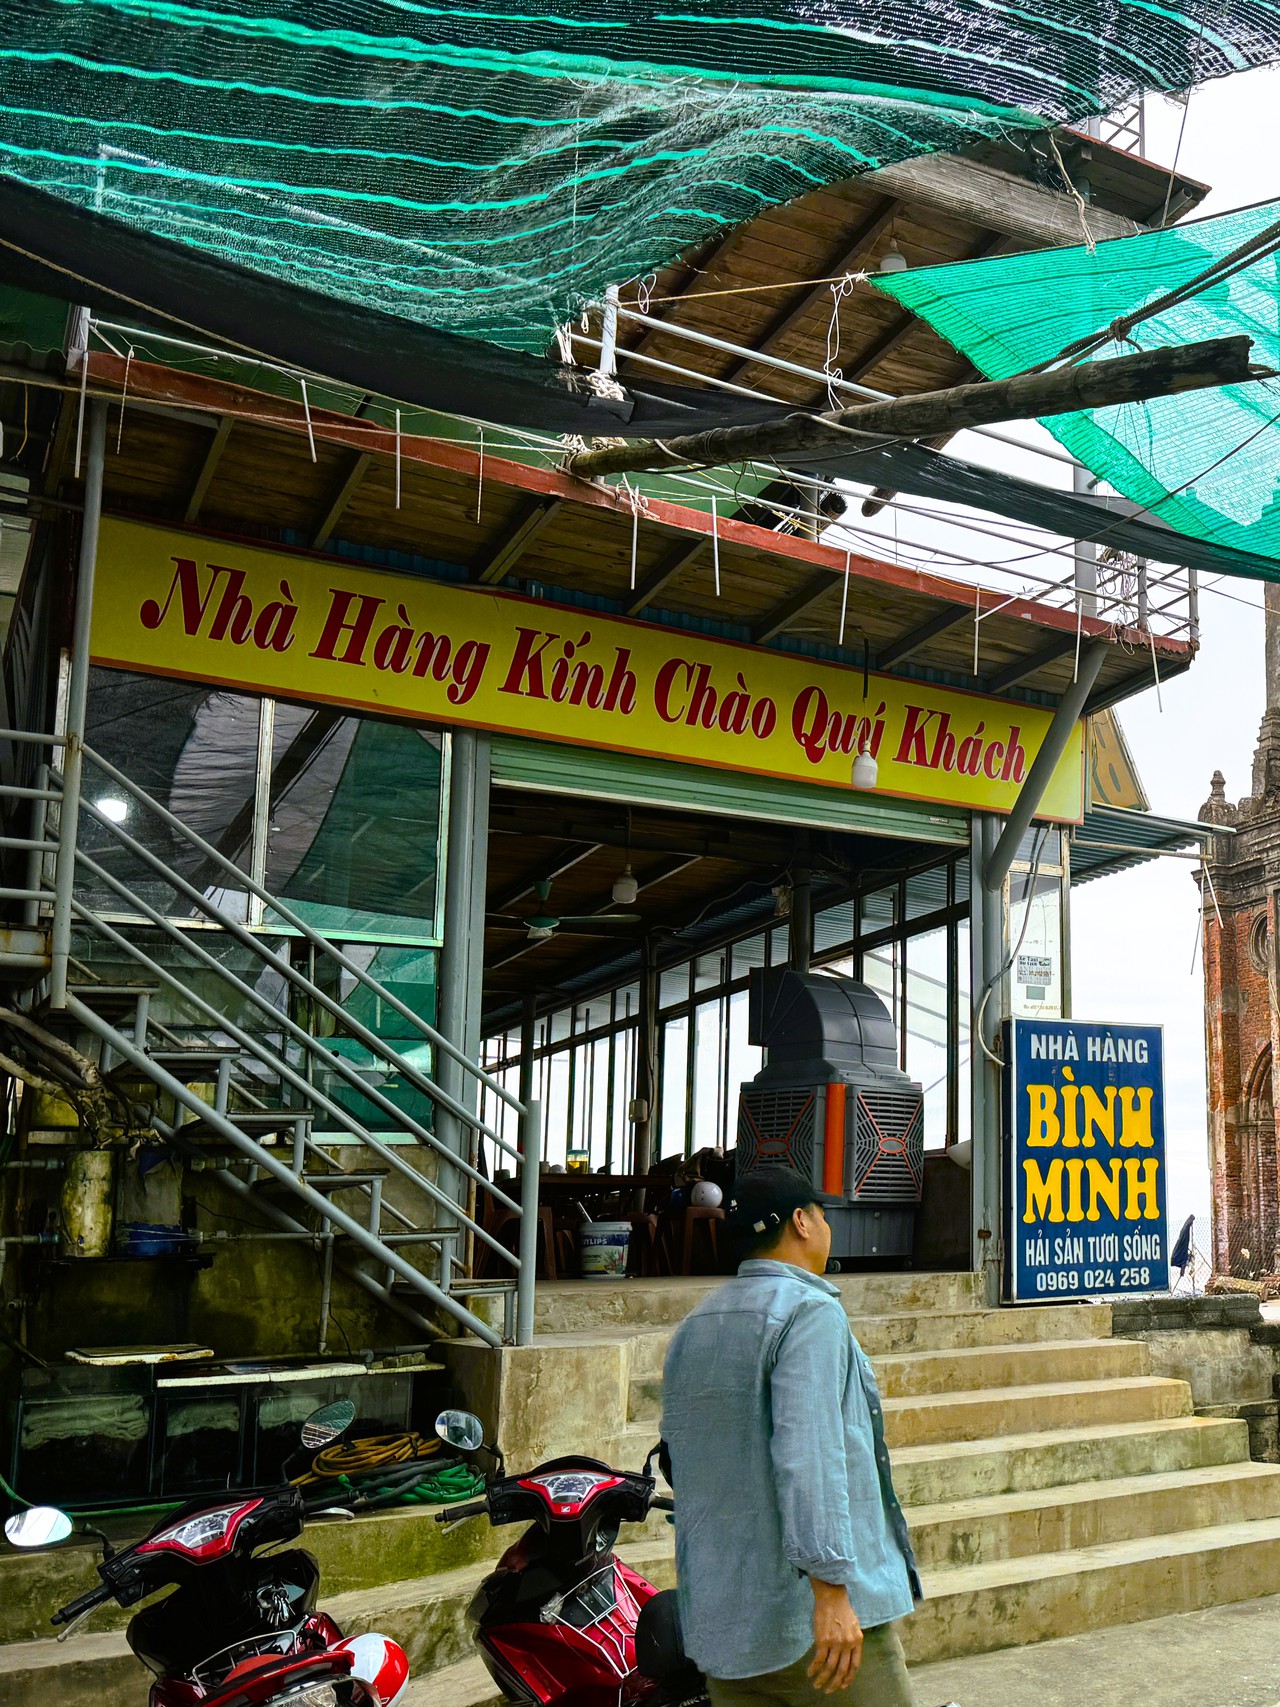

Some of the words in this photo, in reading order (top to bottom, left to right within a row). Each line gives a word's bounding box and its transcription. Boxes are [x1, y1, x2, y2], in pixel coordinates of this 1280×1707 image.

[140, 555, 297, 653] Nhà
[308, 588, 491, 706] Hàng
[497, 627, 638, 716] Kính
[653, 658, 777, 740] Chào
[892, 704, 1026, 784] Khách
[1030, 1030, 1080, 1061] NHÀ
[1087, 1032, 1149, 1064] HÀNG
[1026, 1065, 1155, 1149] BÌNH
[1022, 1158, 1160, 1224] MINH
[1025, 1229, 1050, 1267] HẢI
[1054, 1228, 1084, 1266] SẢN
[1087, 1233, 1119, 1263] TƯƠI
[1123, 1225, 1161, 1262] SỐNG
[1036, 1270, 1079, 1292] 0969
[1084, 1269, 1115, 1289] 024
[1120, 1266, 1150, 1287] 258
